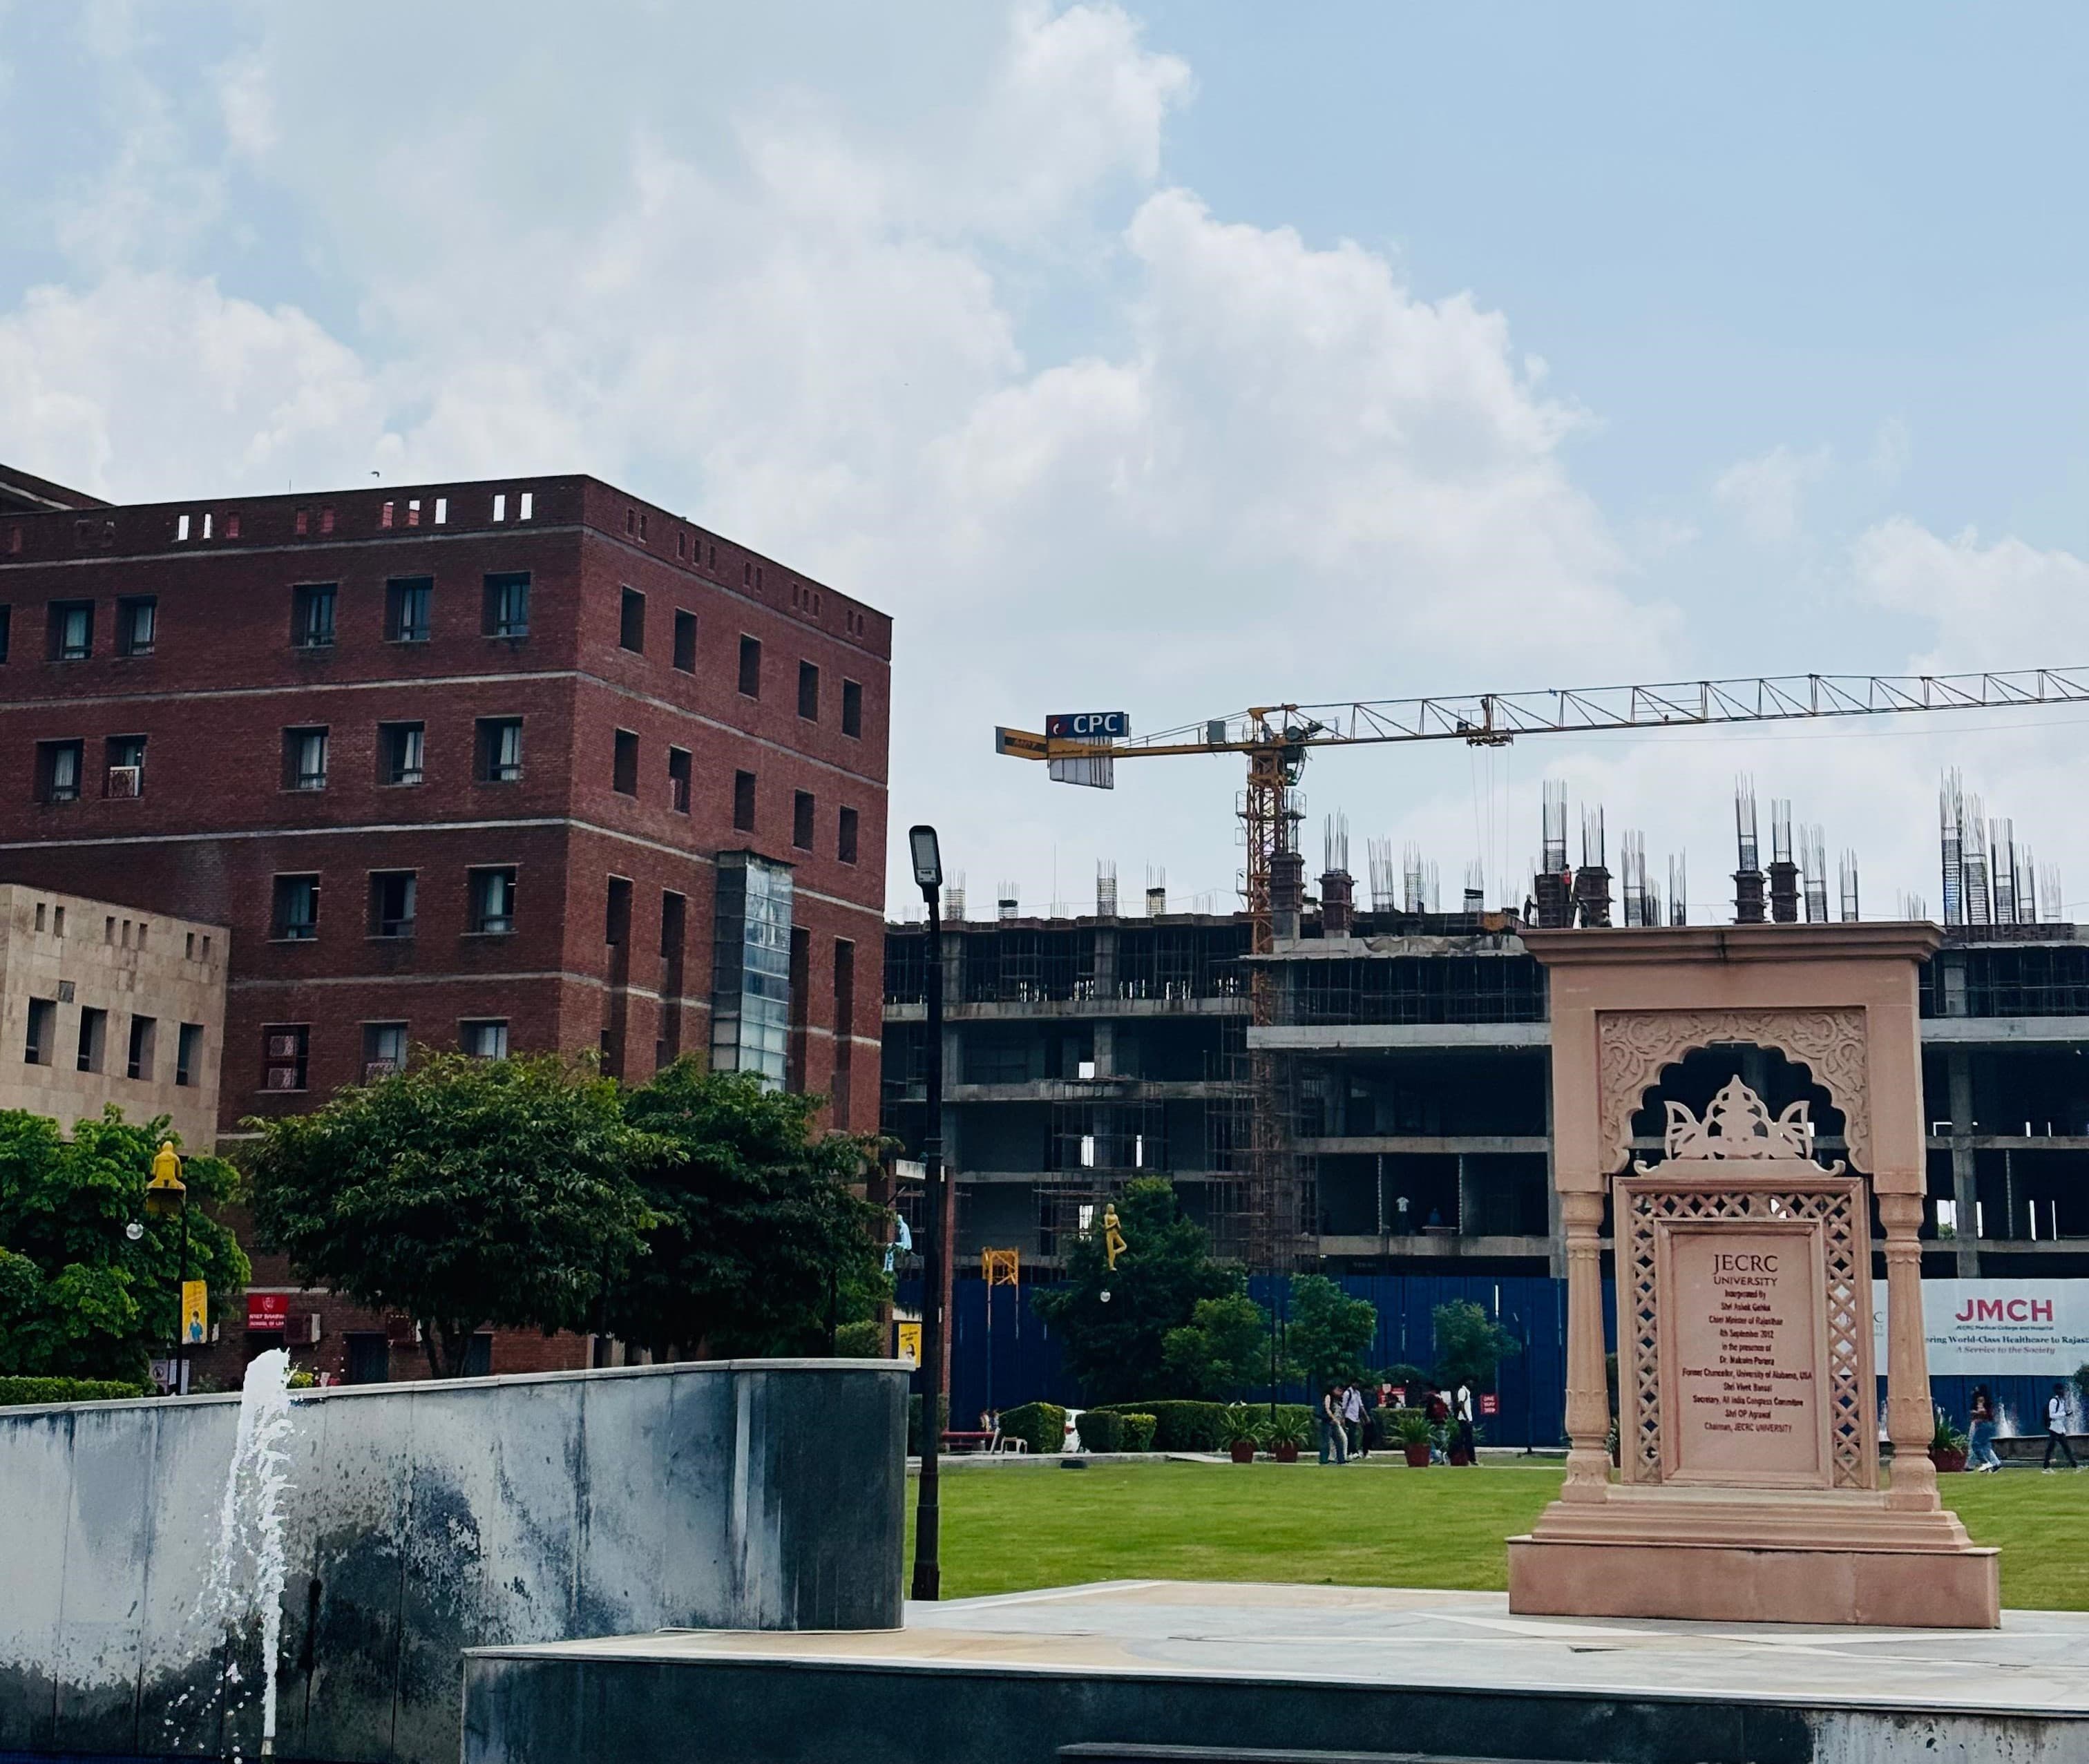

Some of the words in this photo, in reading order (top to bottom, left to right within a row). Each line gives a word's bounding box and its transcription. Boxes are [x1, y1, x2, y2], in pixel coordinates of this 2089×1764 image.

[1074, 713, 1117, 734] CPC
[1713, 1254, 1777, 1274] JECRC
[1714, 1276, 1777, 1286] UNIVERSITY
[1955, 1298, 2053, 1322] JMCH
